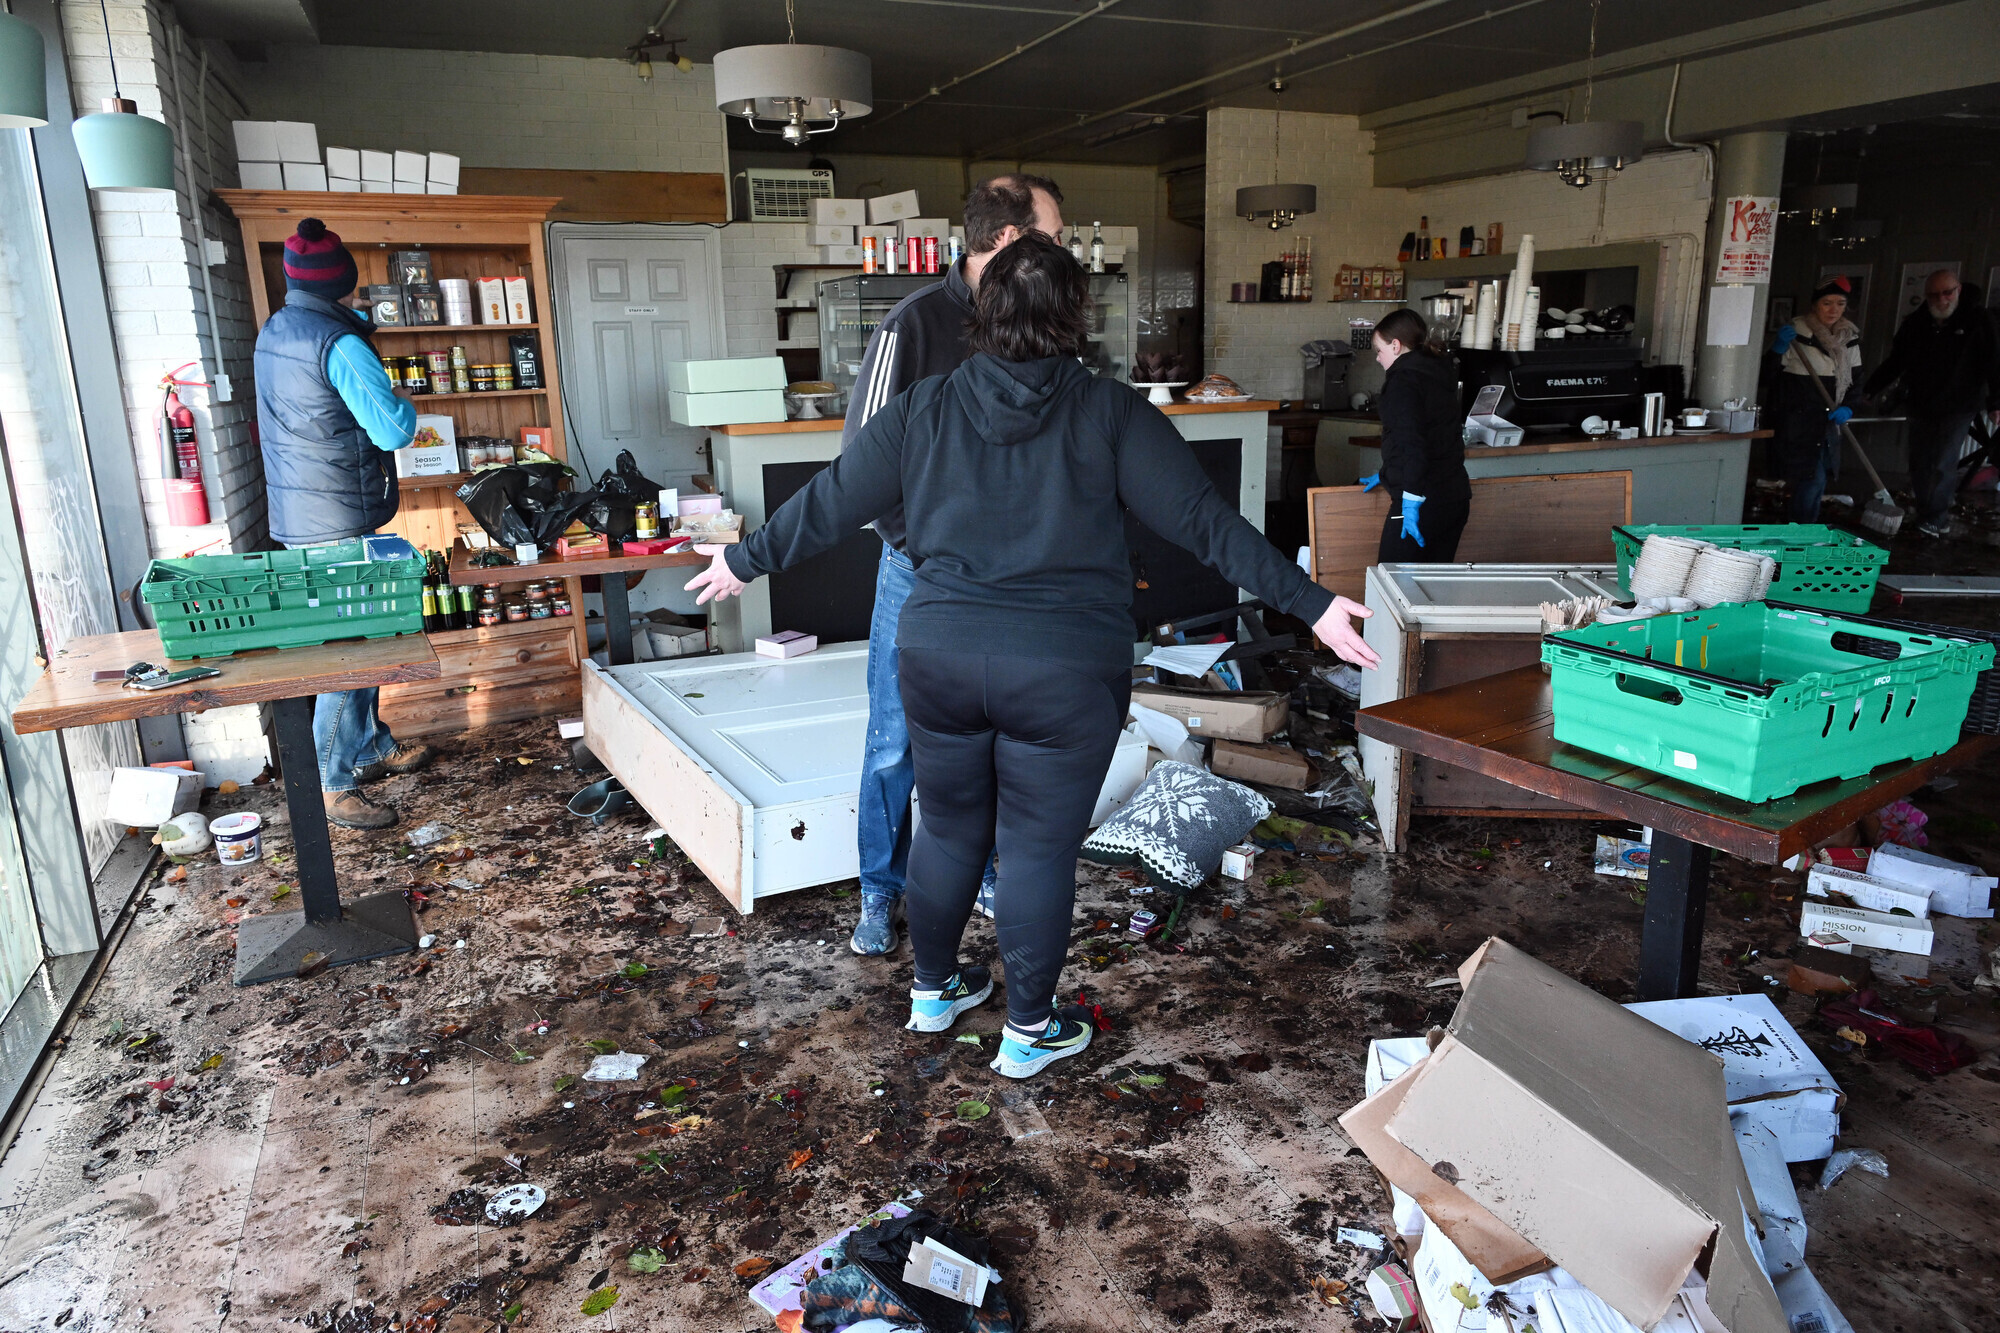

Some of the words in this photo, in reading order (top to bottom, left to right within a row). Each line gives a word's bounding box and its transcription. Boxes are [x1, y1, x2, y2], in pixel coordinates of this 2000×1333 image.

[1546, 378, 1584, 386] FAEMA
[414, 456, 441, 464] Season
[1873, 675, 1891, 686] IFCO
[1831, 868, 1873, 880] TUSCAN
[1822, 905, 1866, 917] MISSION
[1822, 920, 1867, 933] MISSION
